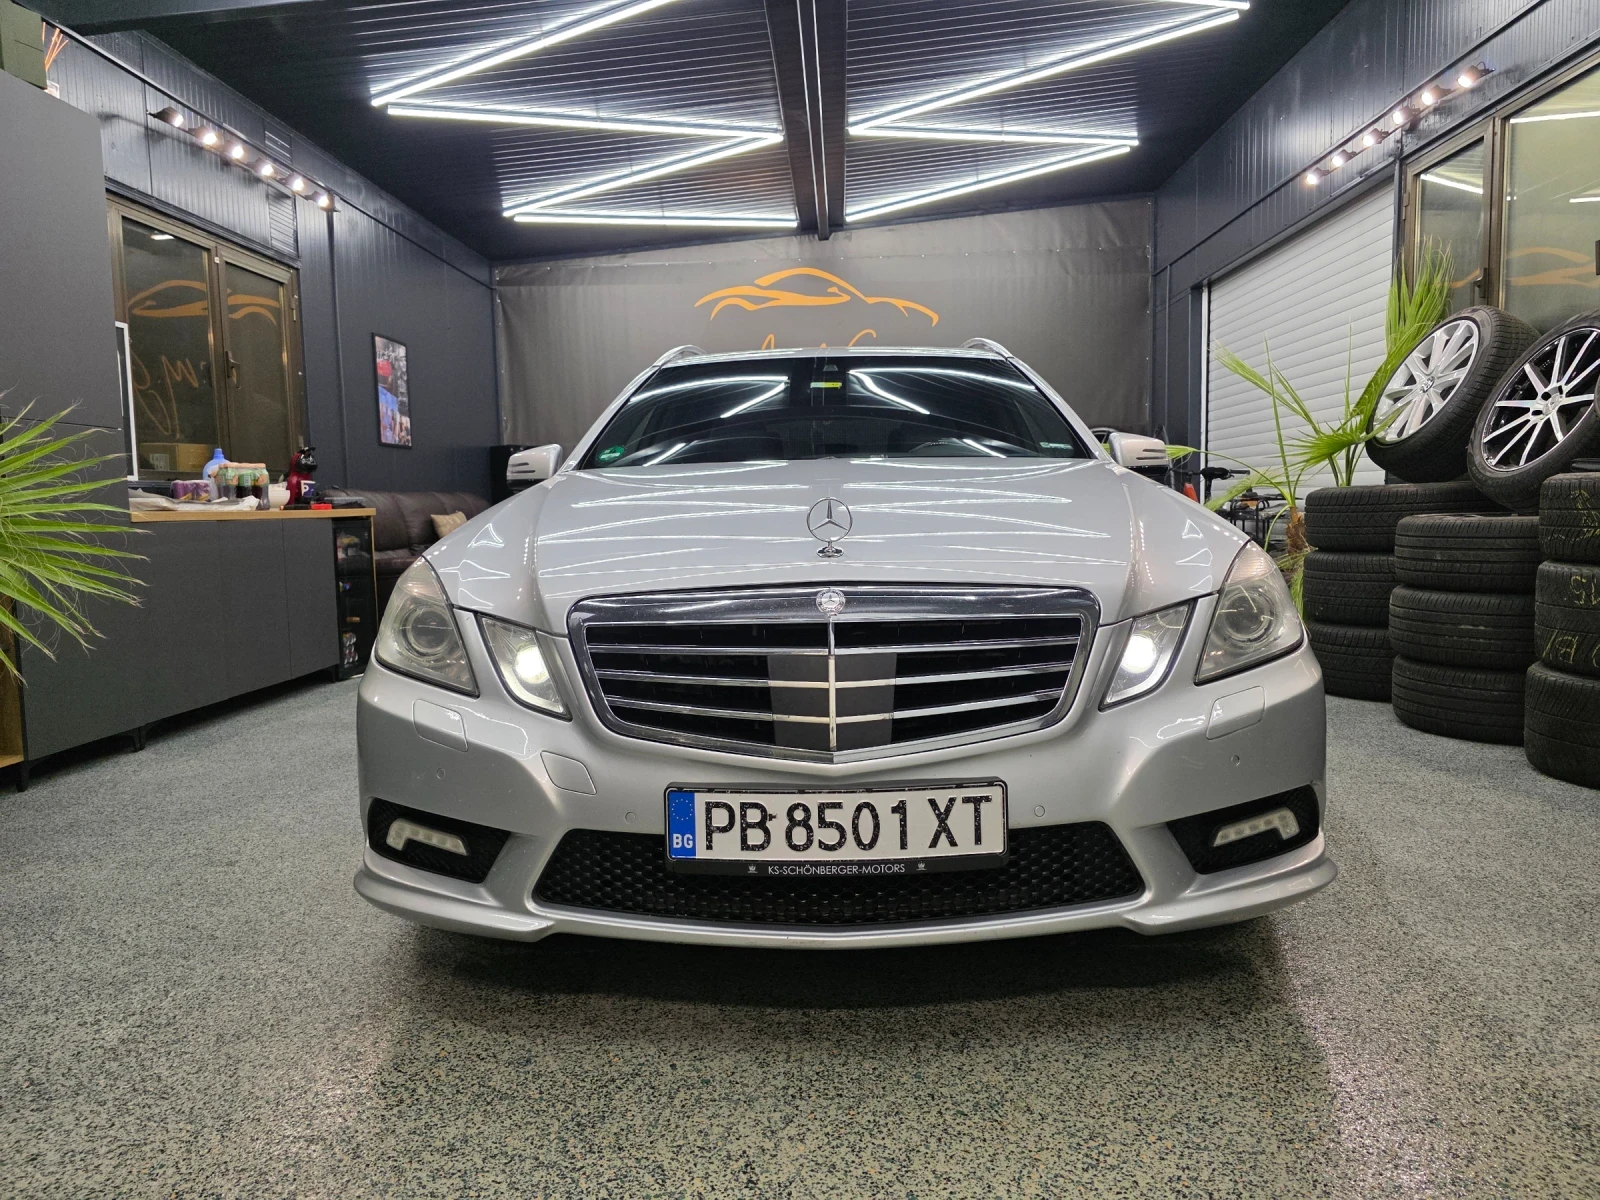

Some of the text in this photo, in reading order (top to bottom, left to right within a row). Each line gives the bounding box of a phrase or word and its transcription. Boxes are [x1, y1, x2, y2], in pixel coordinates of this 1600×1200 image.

[704, 794, 993, 852] PB 8501 XT
[673, 833, 694, 849] BG
[767, 863, 906, 876] KS-SCHÖNBERGER-MOTORS
